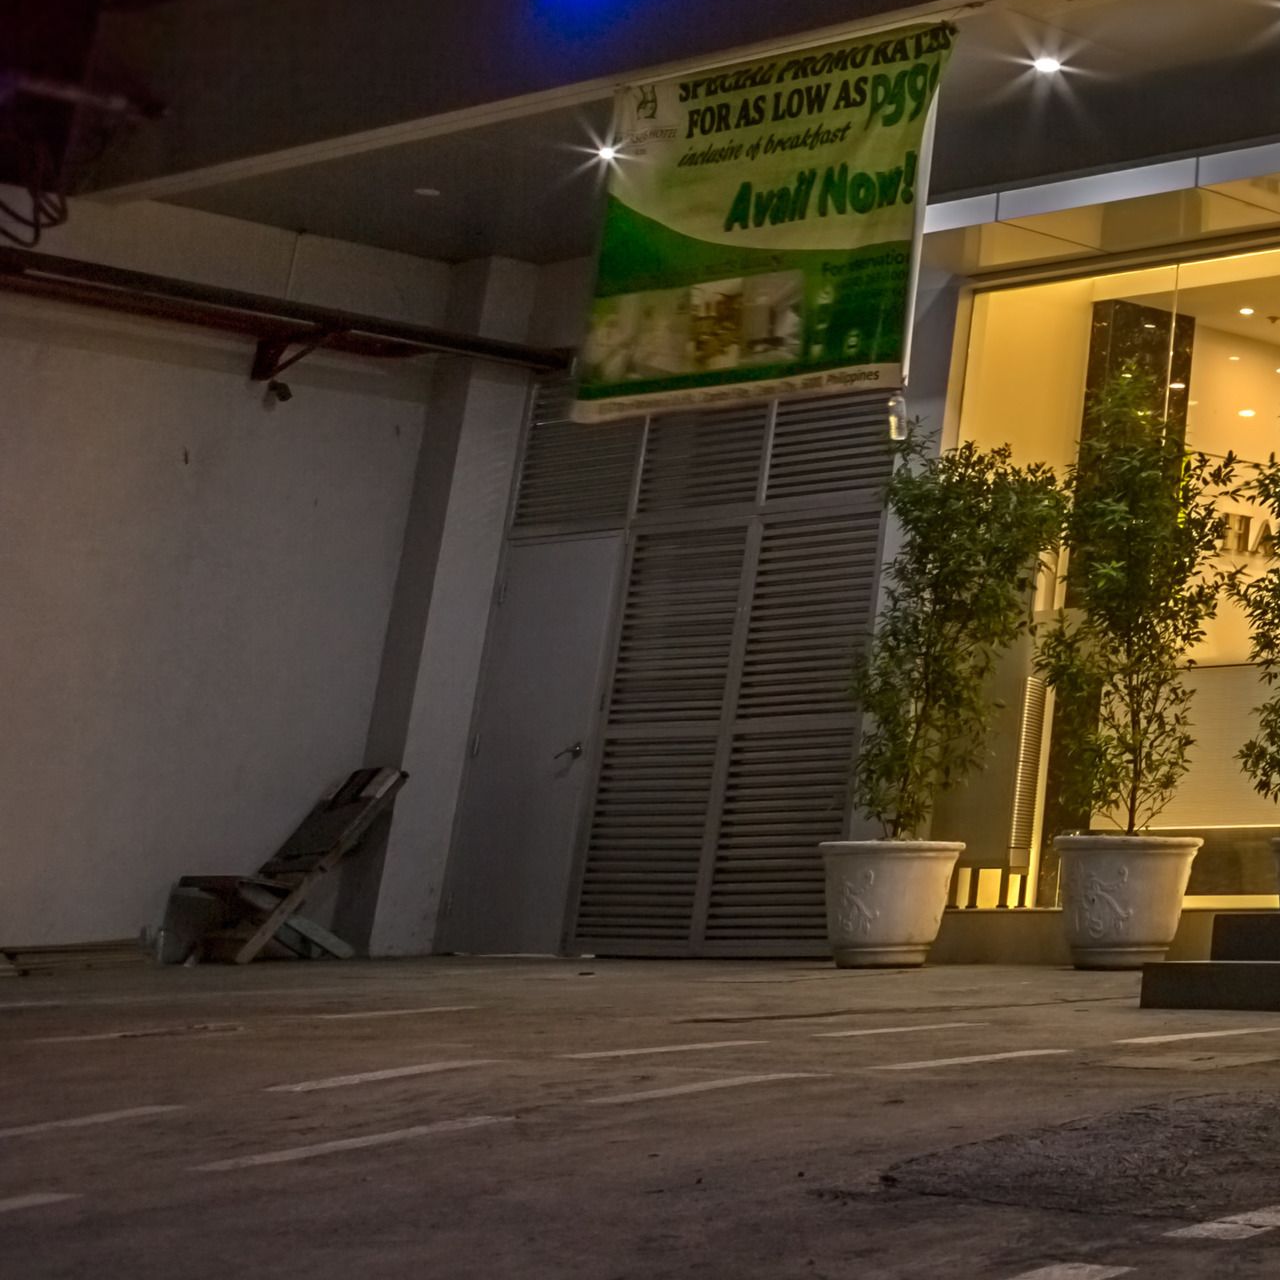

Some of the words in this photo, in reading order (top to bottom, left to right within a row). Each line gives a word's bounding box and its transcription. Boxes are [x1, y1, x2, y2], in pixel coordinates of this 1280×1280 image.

[679, 63, 774, 102] SPECIAL
[776, 45, 873, 84] PROMO
[686, 101, 731, 138] FOR
[734, 94, 766, 128] AS
[772, 81, 832, 121] LOW
[834, 76, 869, 109] AS
[678, 140, 744, 168] inclusive
[745, 136, 761, 161] of
[763, 122, 852, 154] breakfast
[724, 168, 817, 232] Avail
[818, 150, 917, 218] Now!
[826, 369, 880, 387] Philippines
